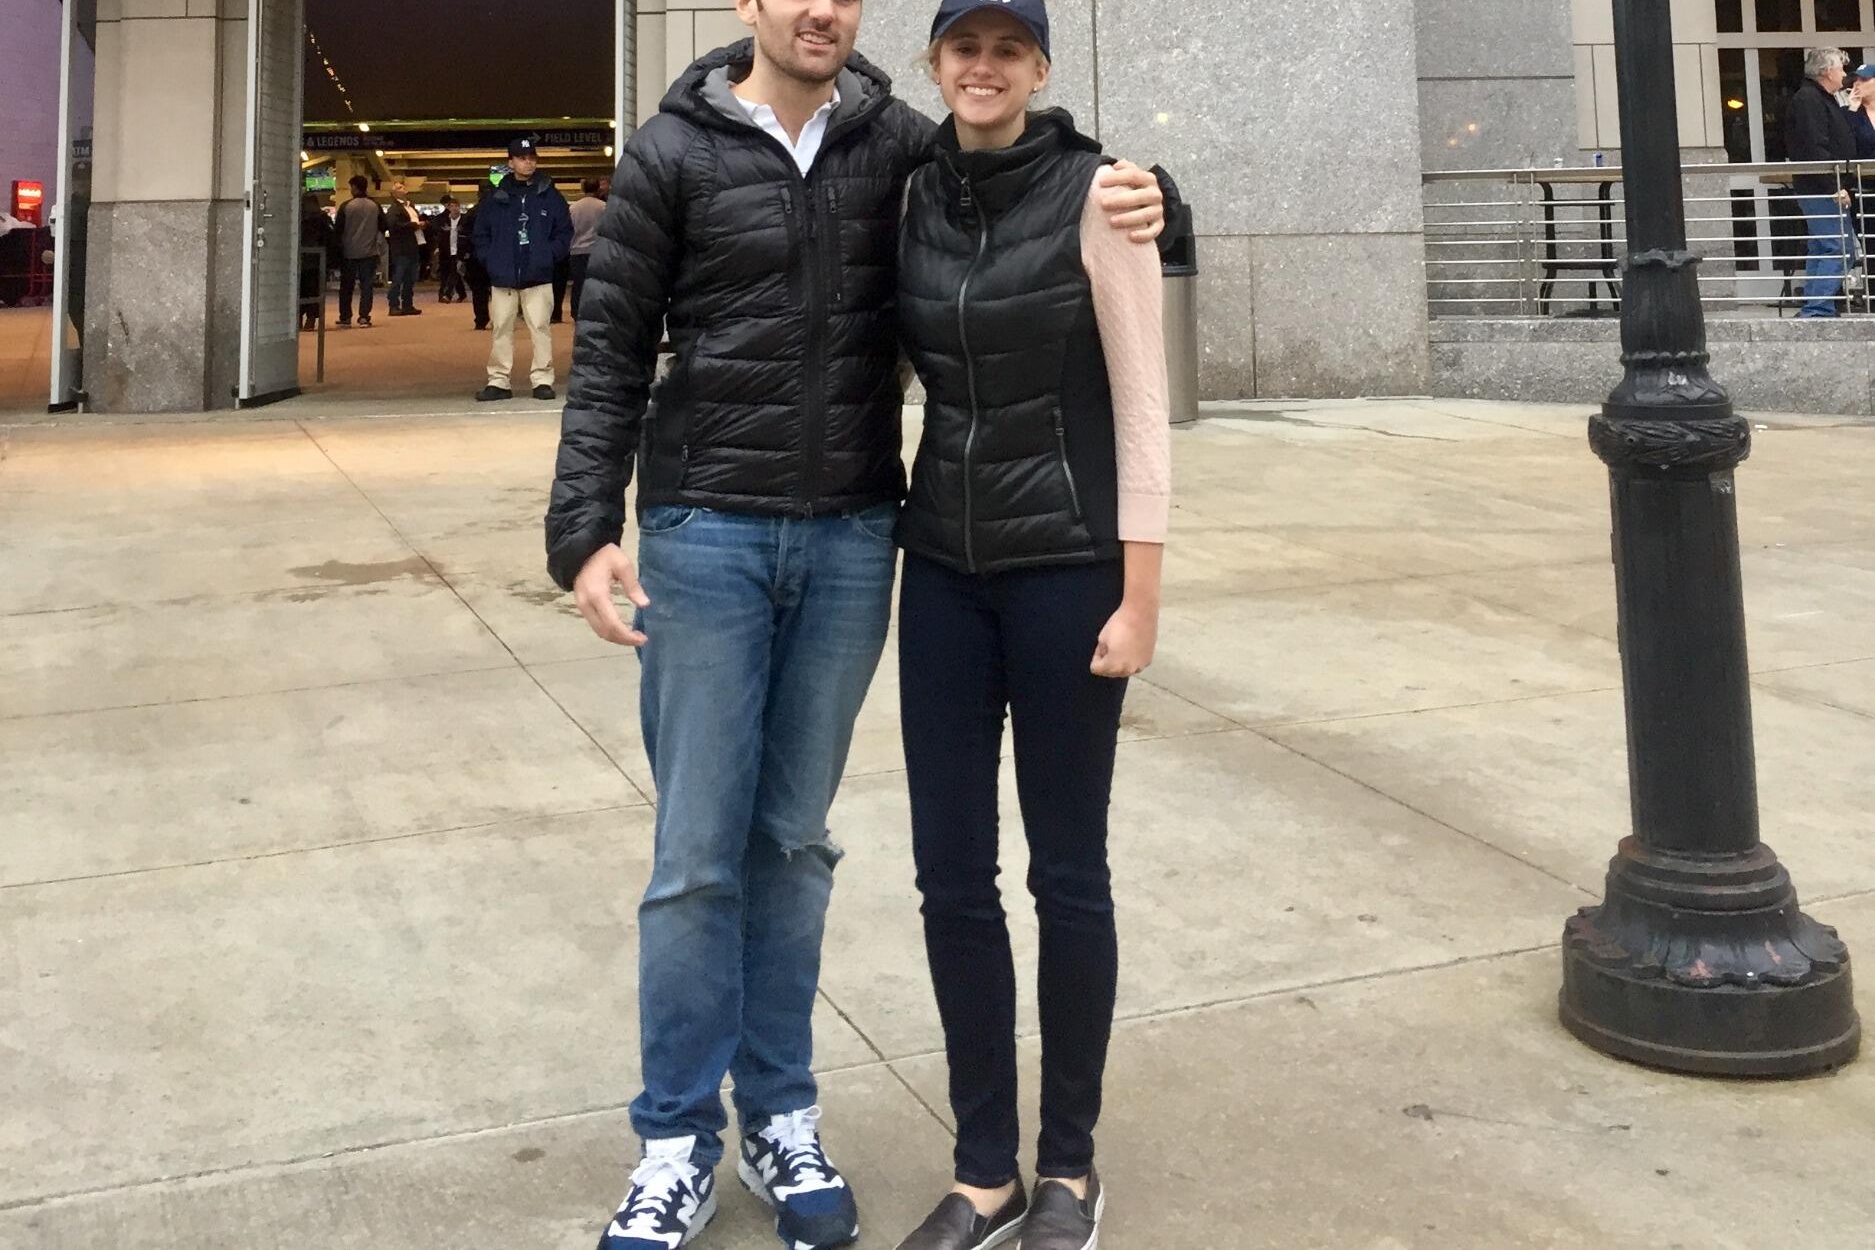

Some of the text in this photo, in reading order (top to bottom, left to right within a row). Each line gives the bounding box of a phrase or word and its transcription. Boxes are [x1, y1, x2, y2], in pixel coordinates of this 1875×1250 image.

[316, 135, 360, 147] LEGENDS
[544, 132, 602, 143] FIELD LEVEL
